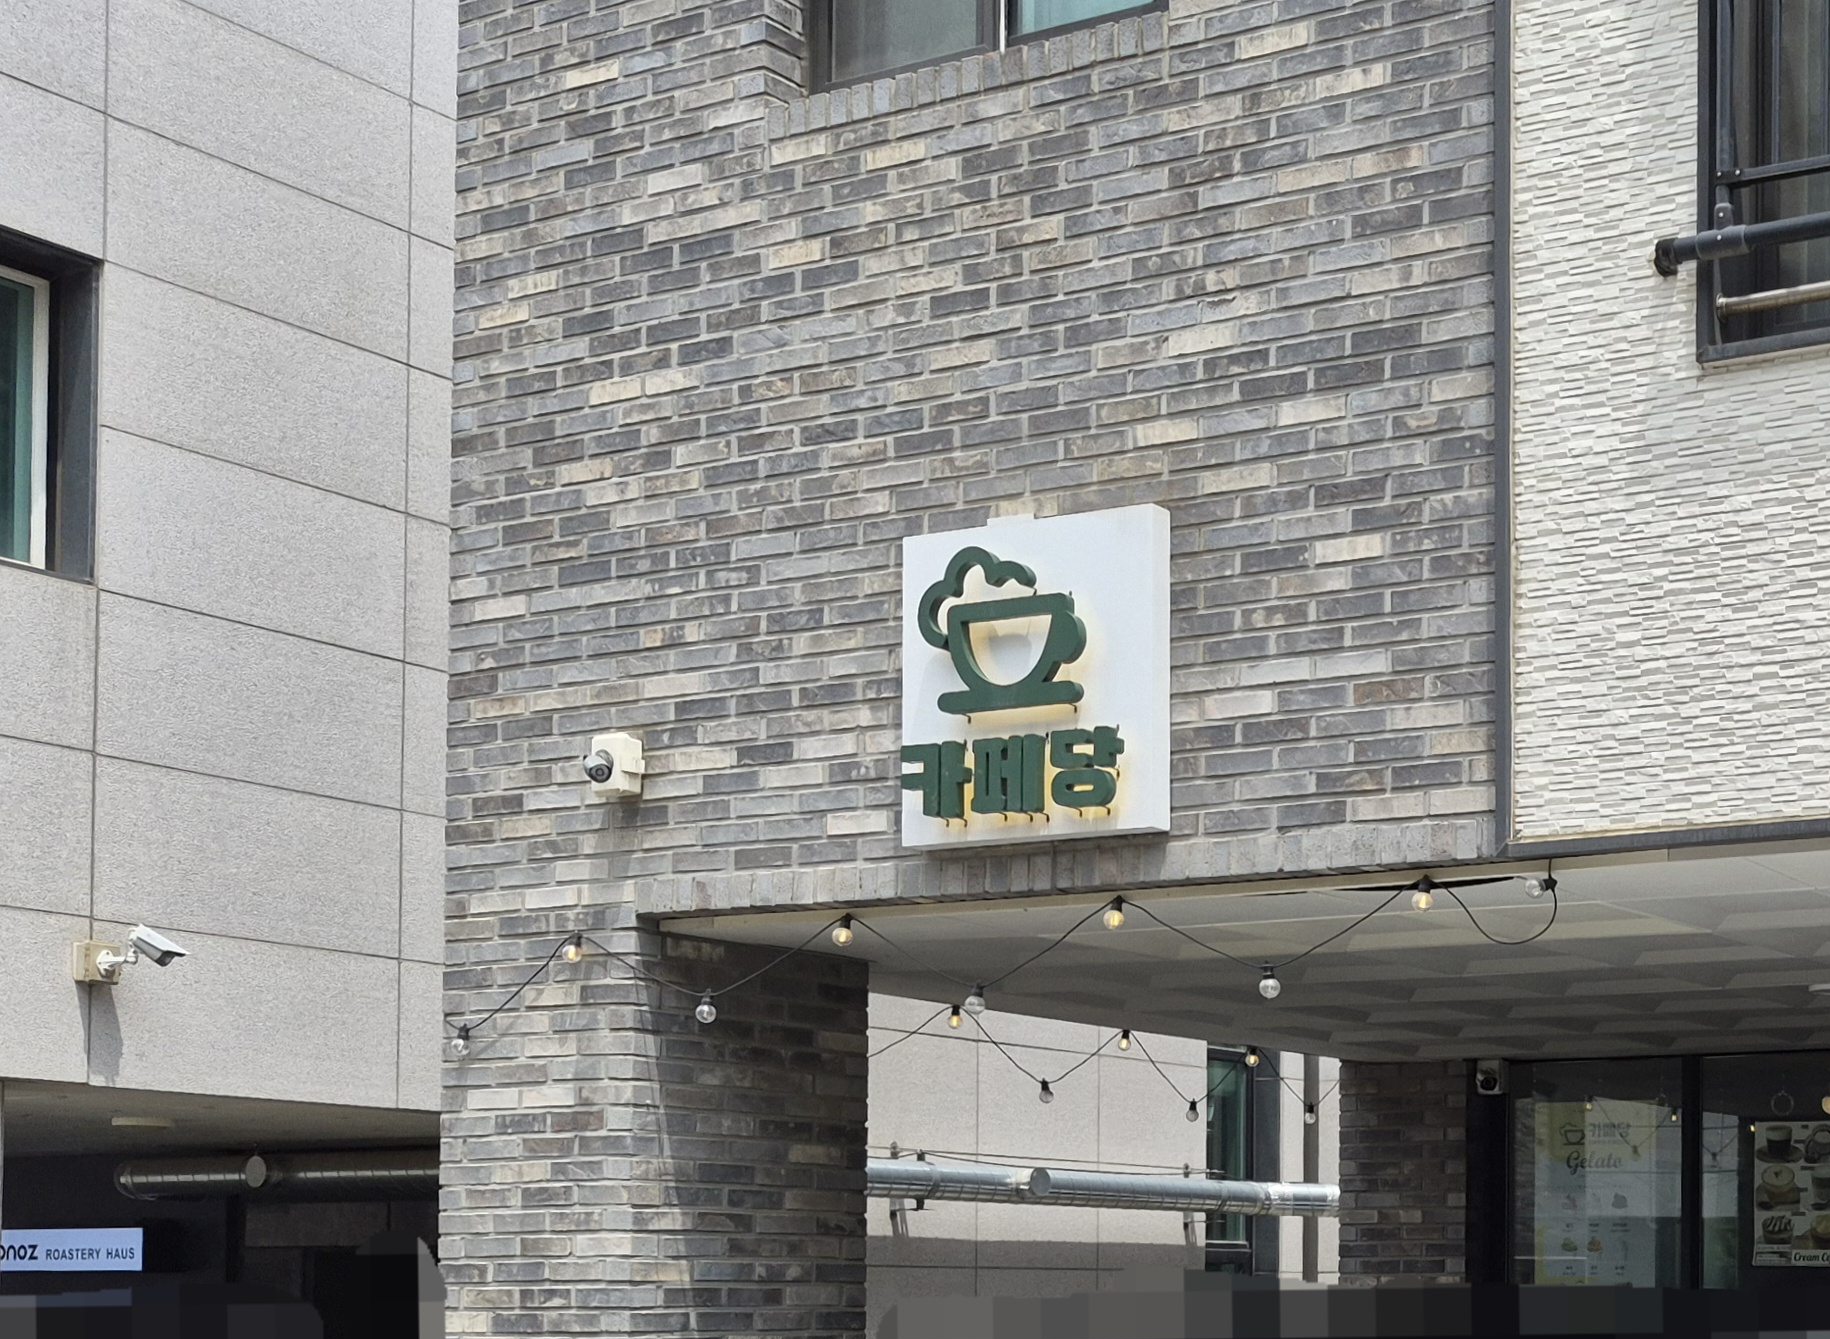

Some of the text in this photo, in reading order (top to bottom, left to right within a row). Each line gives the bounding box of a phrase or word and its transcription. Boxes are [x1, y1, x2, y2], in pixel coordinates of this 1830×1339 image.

[900, 724, 1124, 818] 카페당
[1567, 1150, 1623, 1175] Gelato
[45, 1248, 101, 1260] ROASTERY
[106, 1247, 135, 1259] HAUS
[1794, 1252, 1820, 1262] Cream
